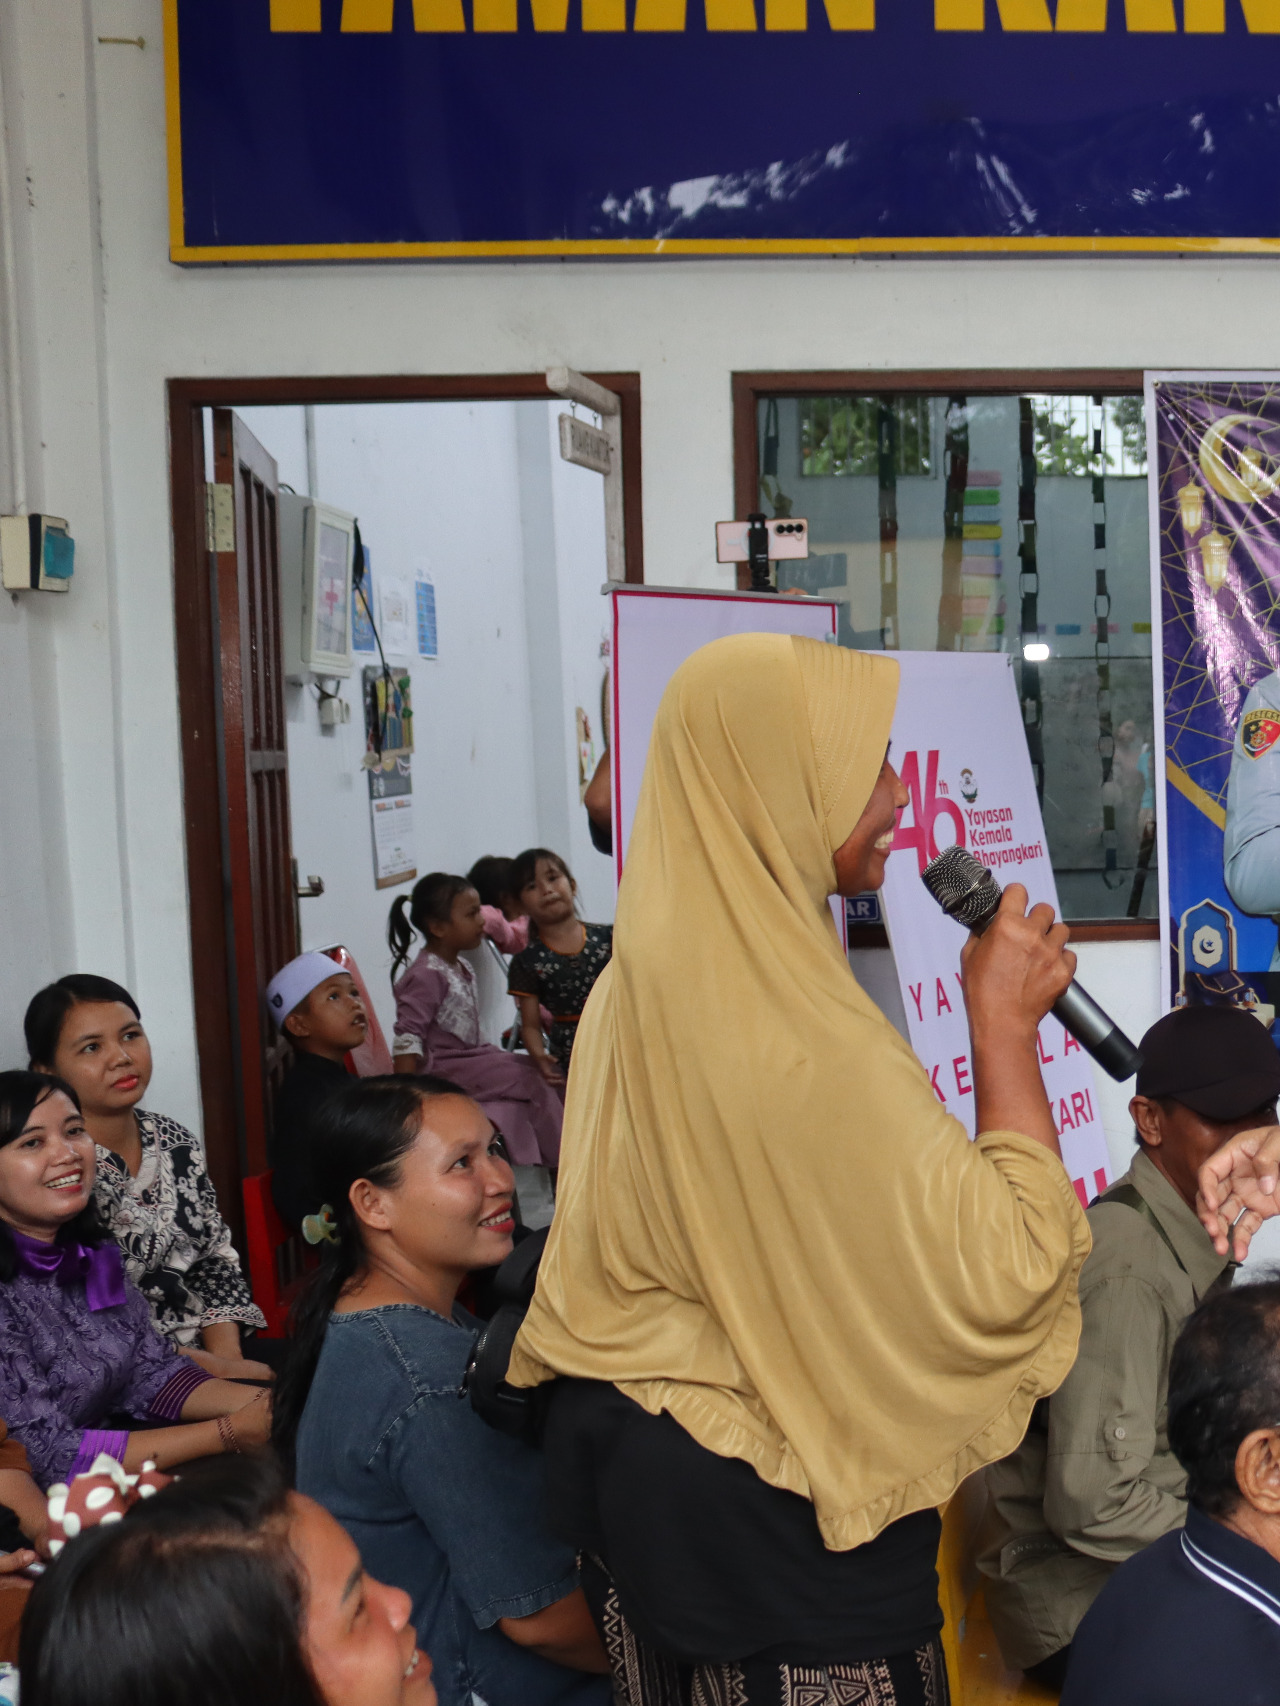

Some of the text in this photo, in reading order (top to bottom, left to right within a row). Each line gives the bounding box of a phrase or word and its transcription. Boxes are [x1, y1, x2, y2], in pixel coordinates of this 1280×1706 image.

[965, 807, 1013, 828] Yayasan
[969, 827, 1013, 847] Kemala
[974, 841, 1044, 868] Bhayangkari
